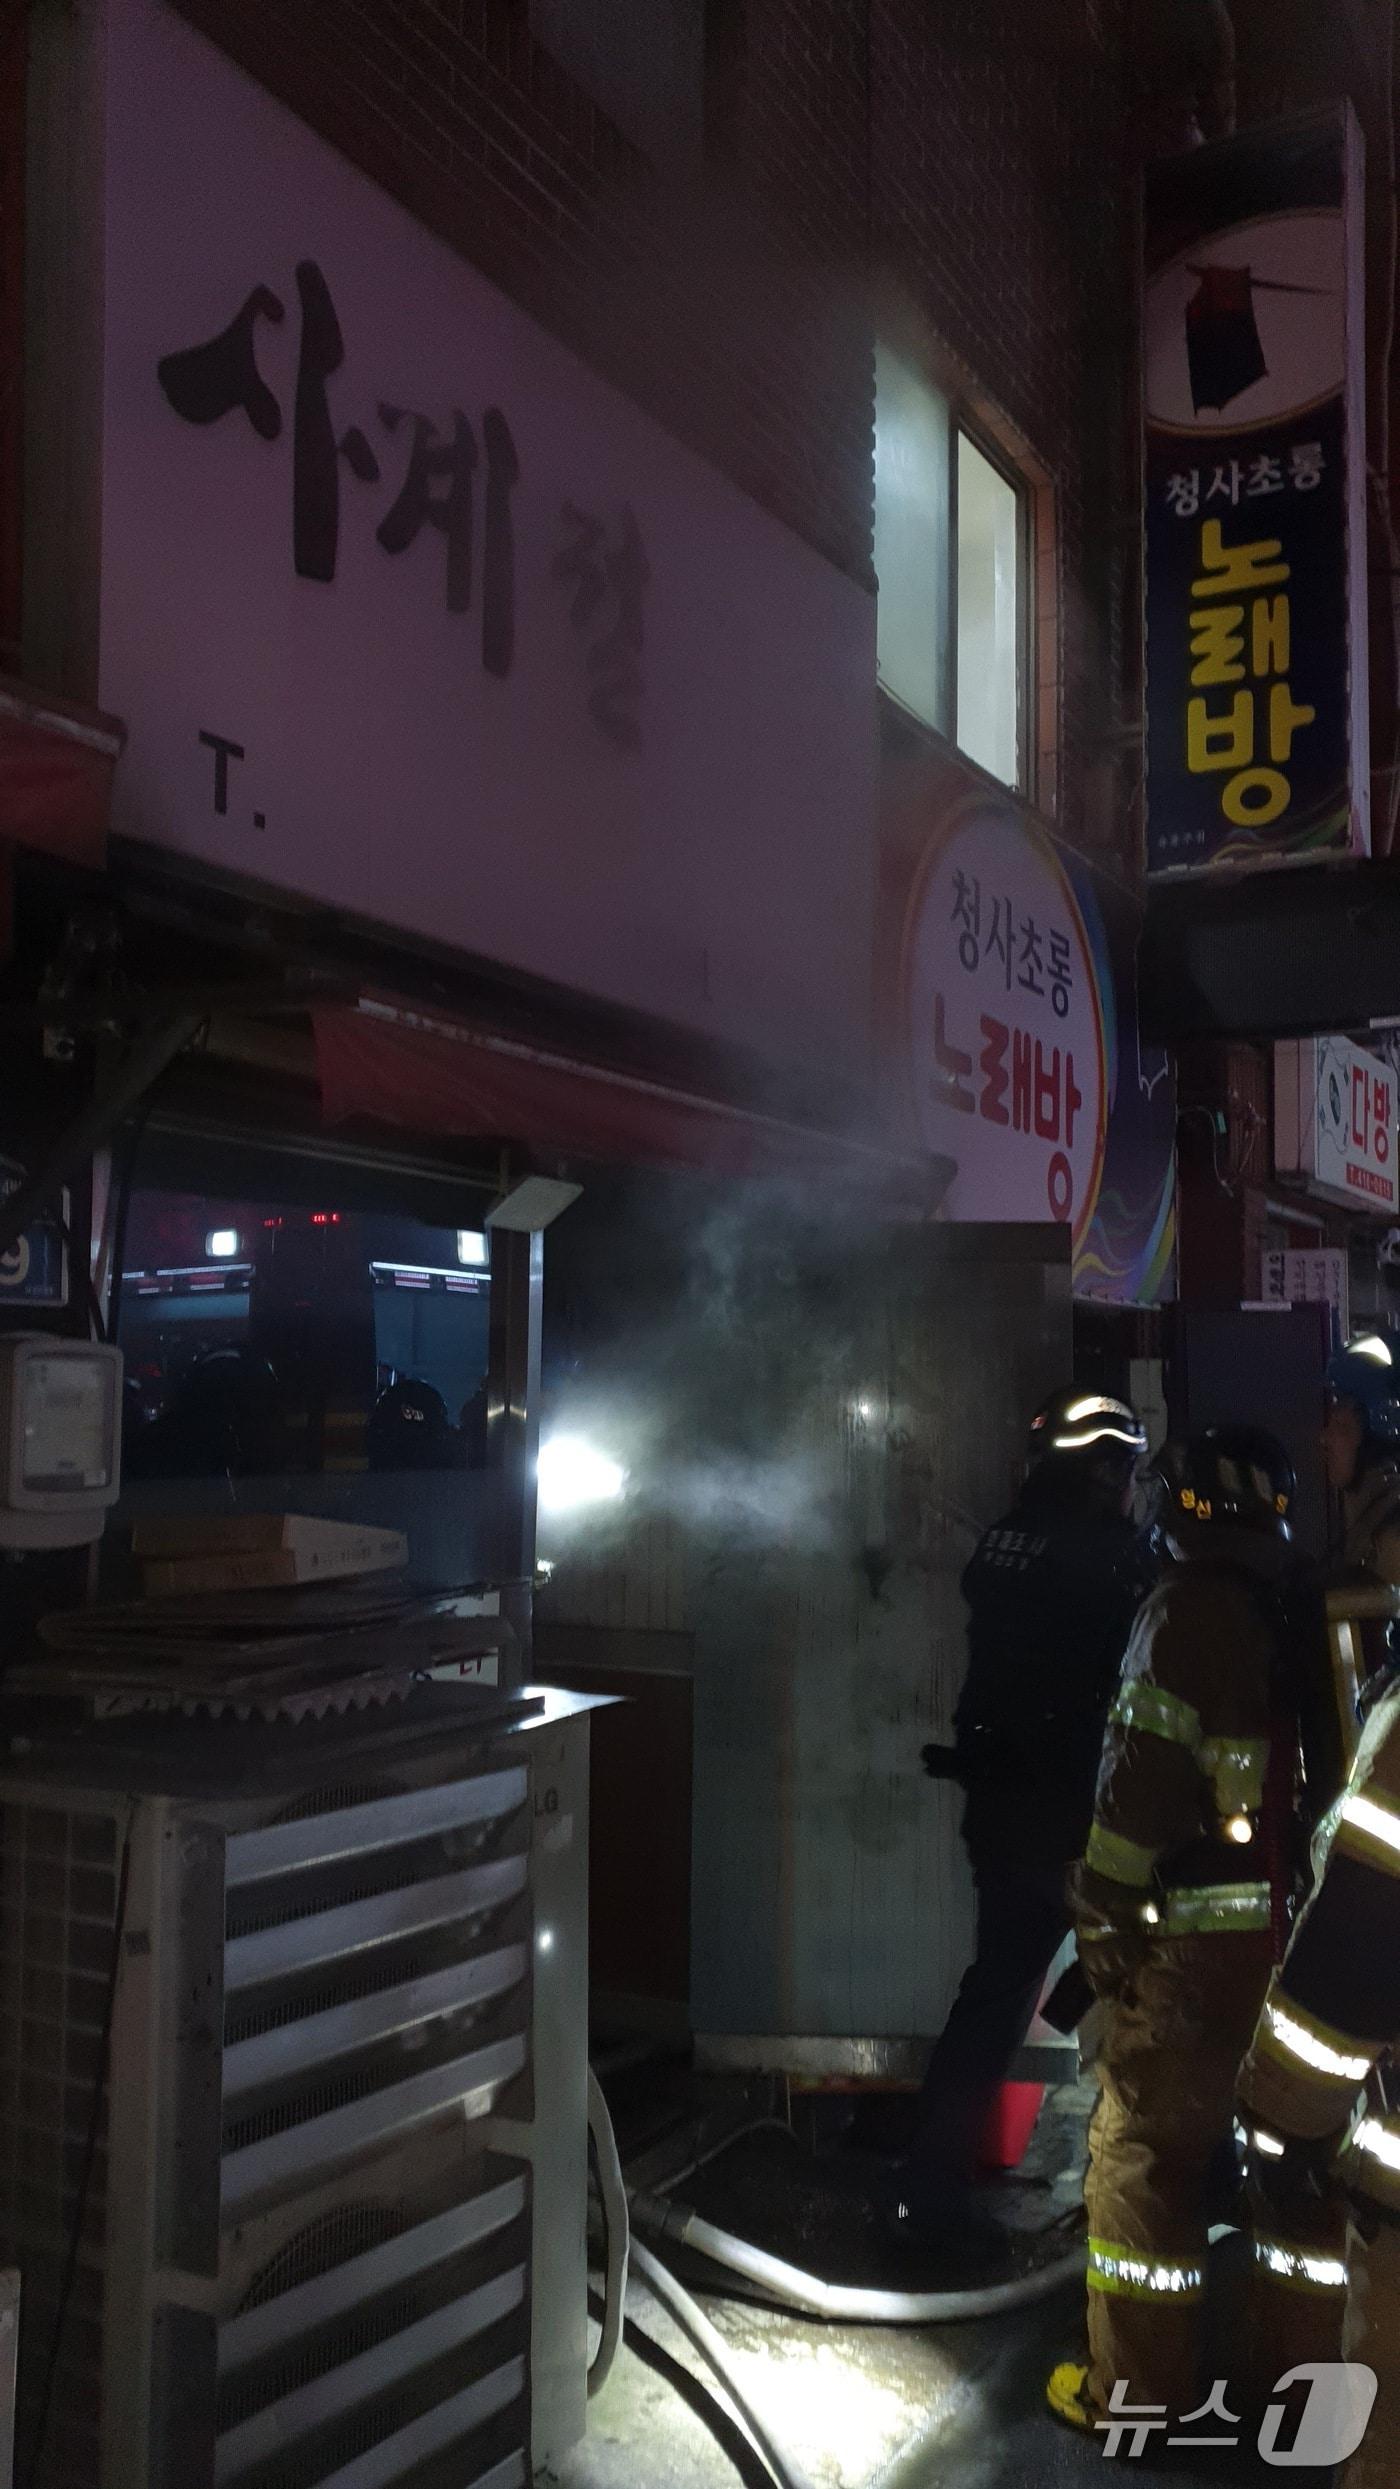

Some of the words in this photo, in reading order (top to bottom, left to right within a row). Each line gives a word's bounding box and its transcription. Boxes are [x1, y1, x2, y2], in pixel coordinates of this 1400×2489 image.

[1186, 517, 1316, 828] 노래방
[950, 867, 1073, 1018] 청사초롱
[929, 992, 1082, 1223] 노래방
[1352, 1065, 1391, 1163] 다방
